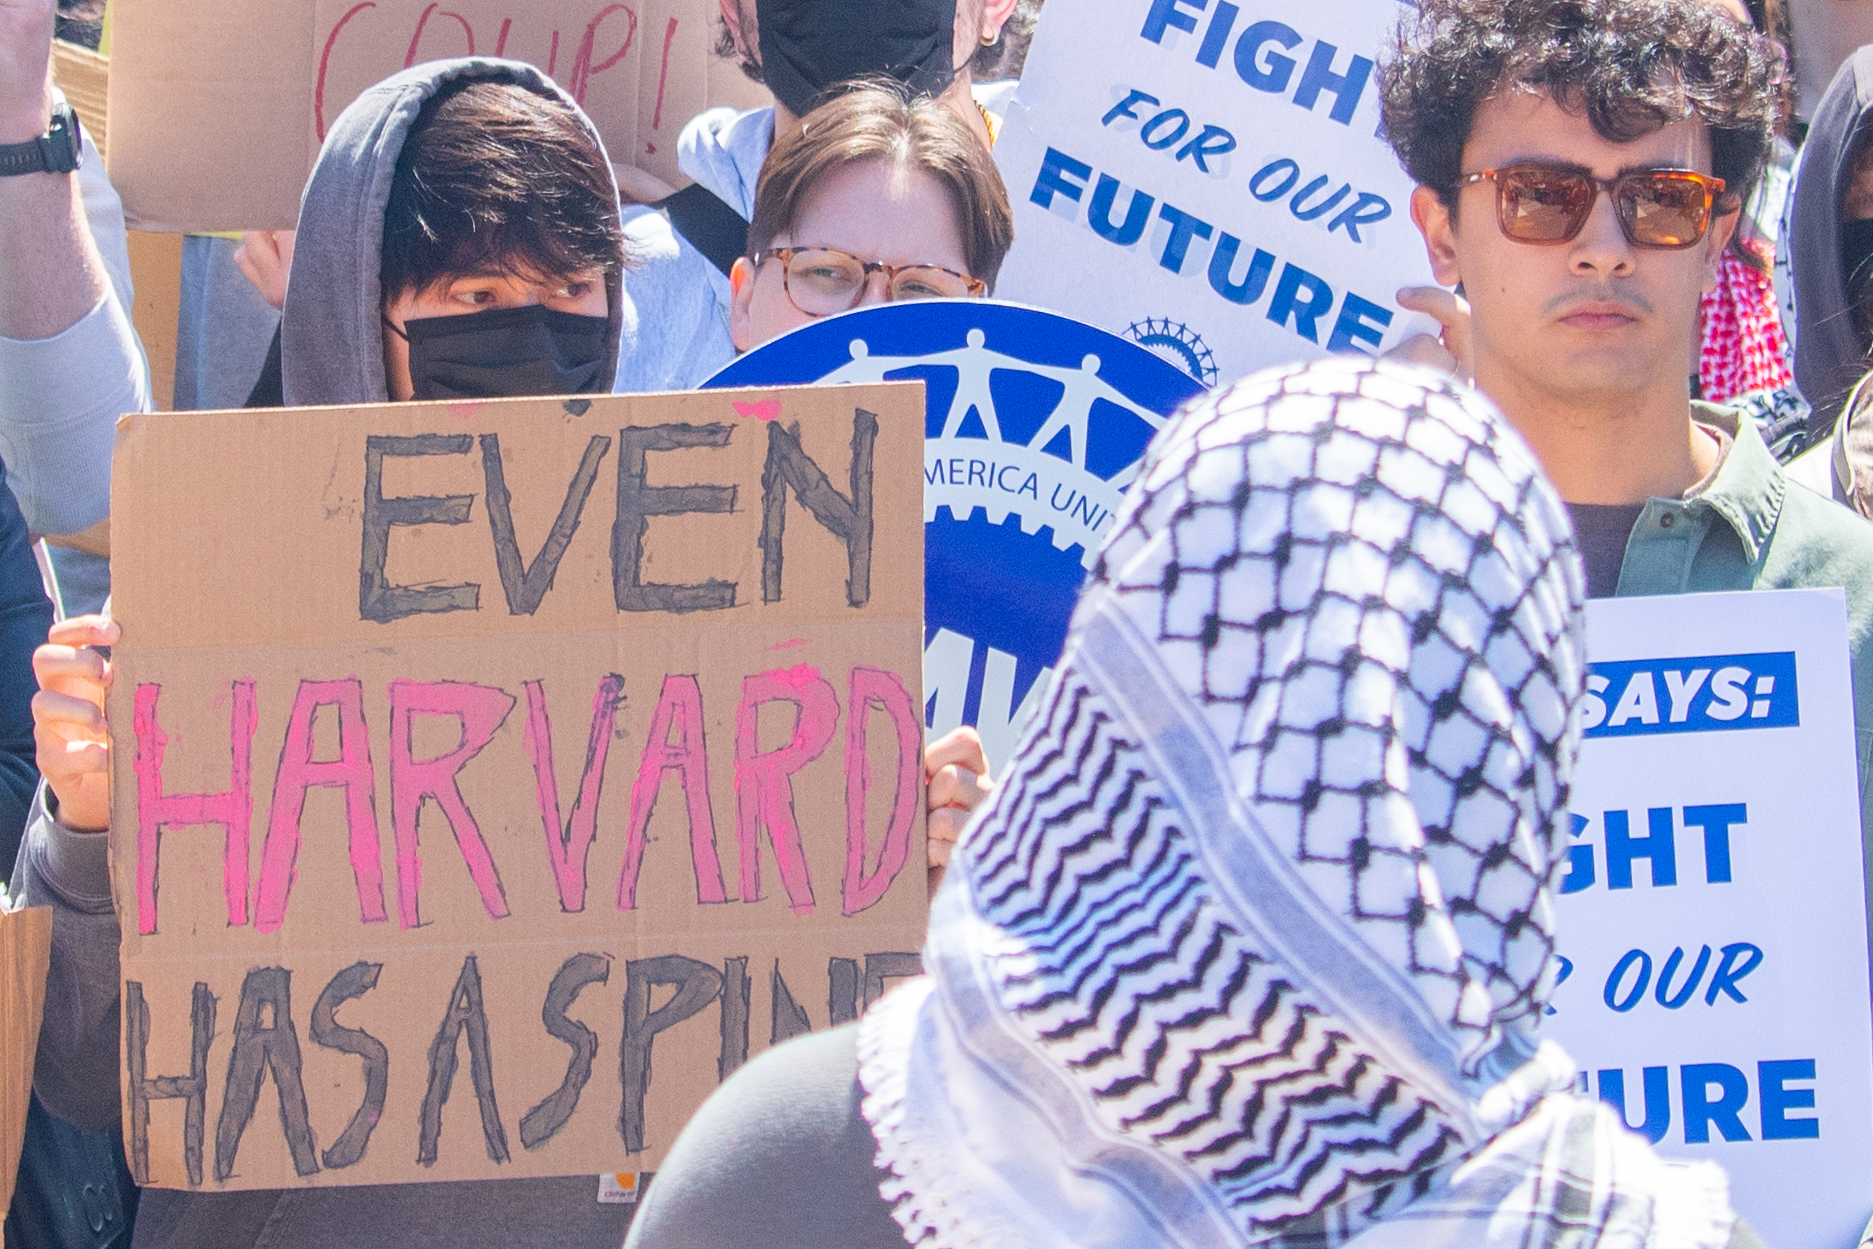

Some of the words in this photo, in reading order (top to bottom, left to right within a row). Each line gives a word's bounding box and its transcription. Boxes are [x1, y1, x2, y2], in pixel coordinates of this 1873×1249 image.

[1028, 145, 1394, 355] FUTURE
[1101, 88, 1237, 174] FOR
[1247, 156, 1392, 244] OUR
[358, 408, 879, 623] EVEN
[924, 458, 1039, 501] MERICA
[1050, 482, 1116, 533] UNI
[133, 663, 924, 937] HARVARD
[125, 960, 389, 1187] HAS
[415, 955, 513, 1167] A
[1602, 941, 1765, 1013] OUR
